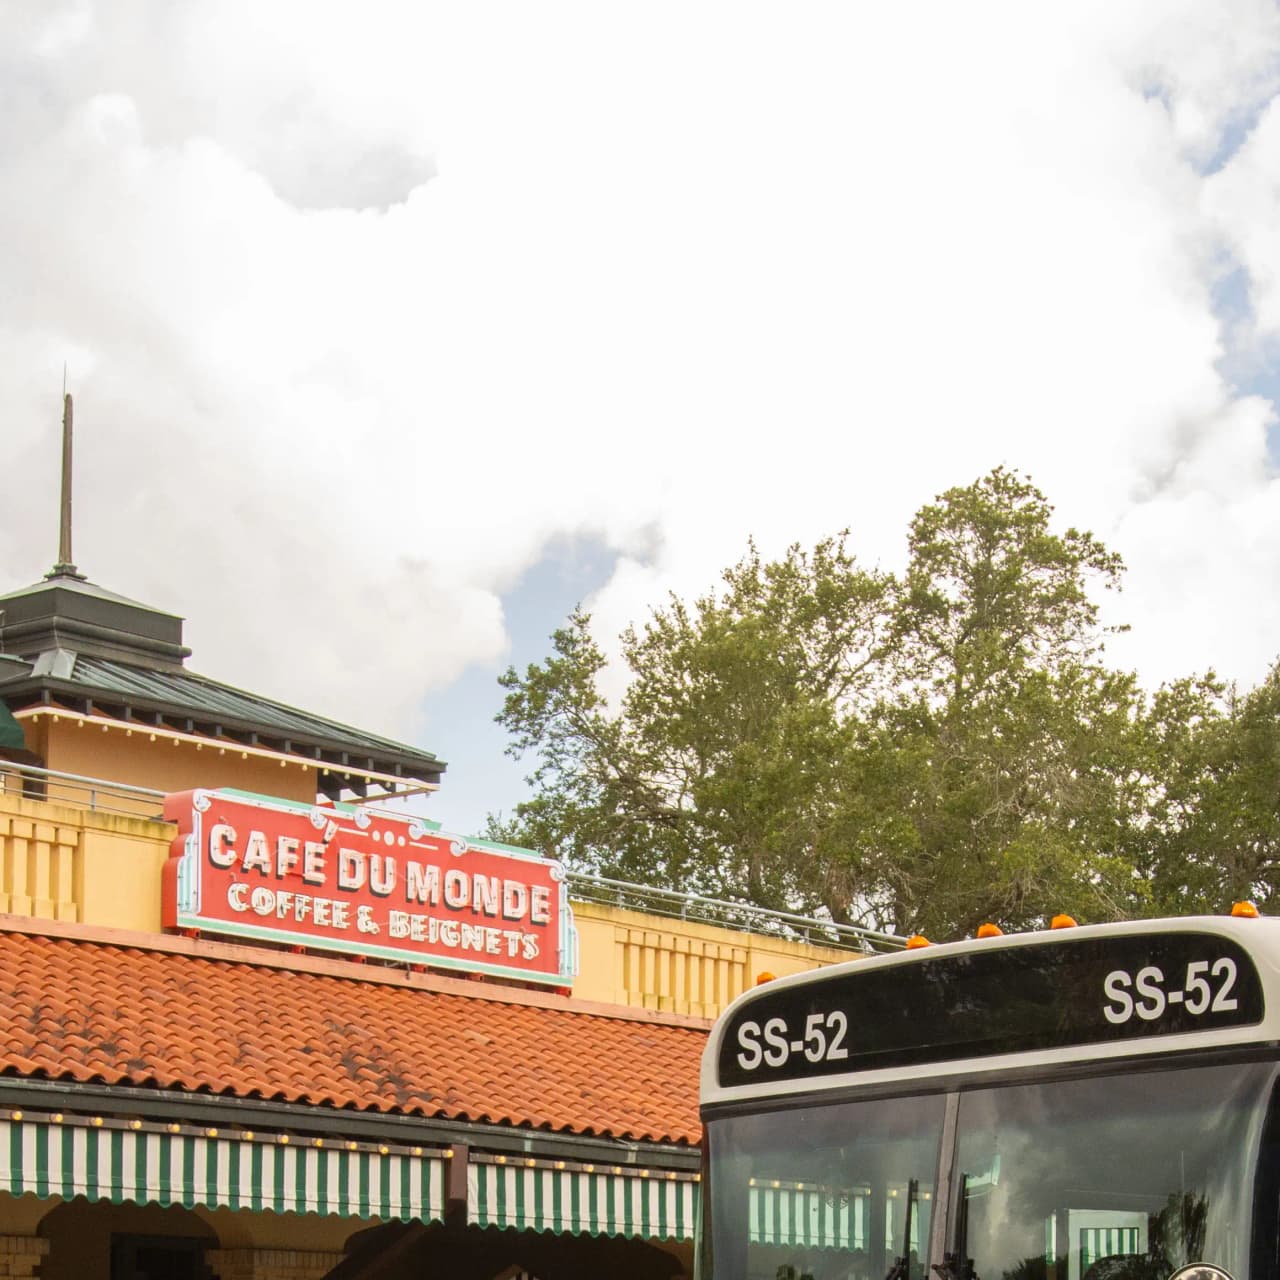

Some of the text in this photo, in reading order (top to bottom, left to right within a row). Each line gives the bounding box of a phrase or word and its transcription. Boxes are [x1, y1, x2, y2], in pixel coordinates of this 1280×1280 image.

[209, 820, 553, 925] CAFÉ DU MONDE
[227, 881, 541, 961] COFFEE & BEIGNETS
[1103, 956, 1239, 1025] SS-52
[736, 1009, 850, 1071] SS-52
